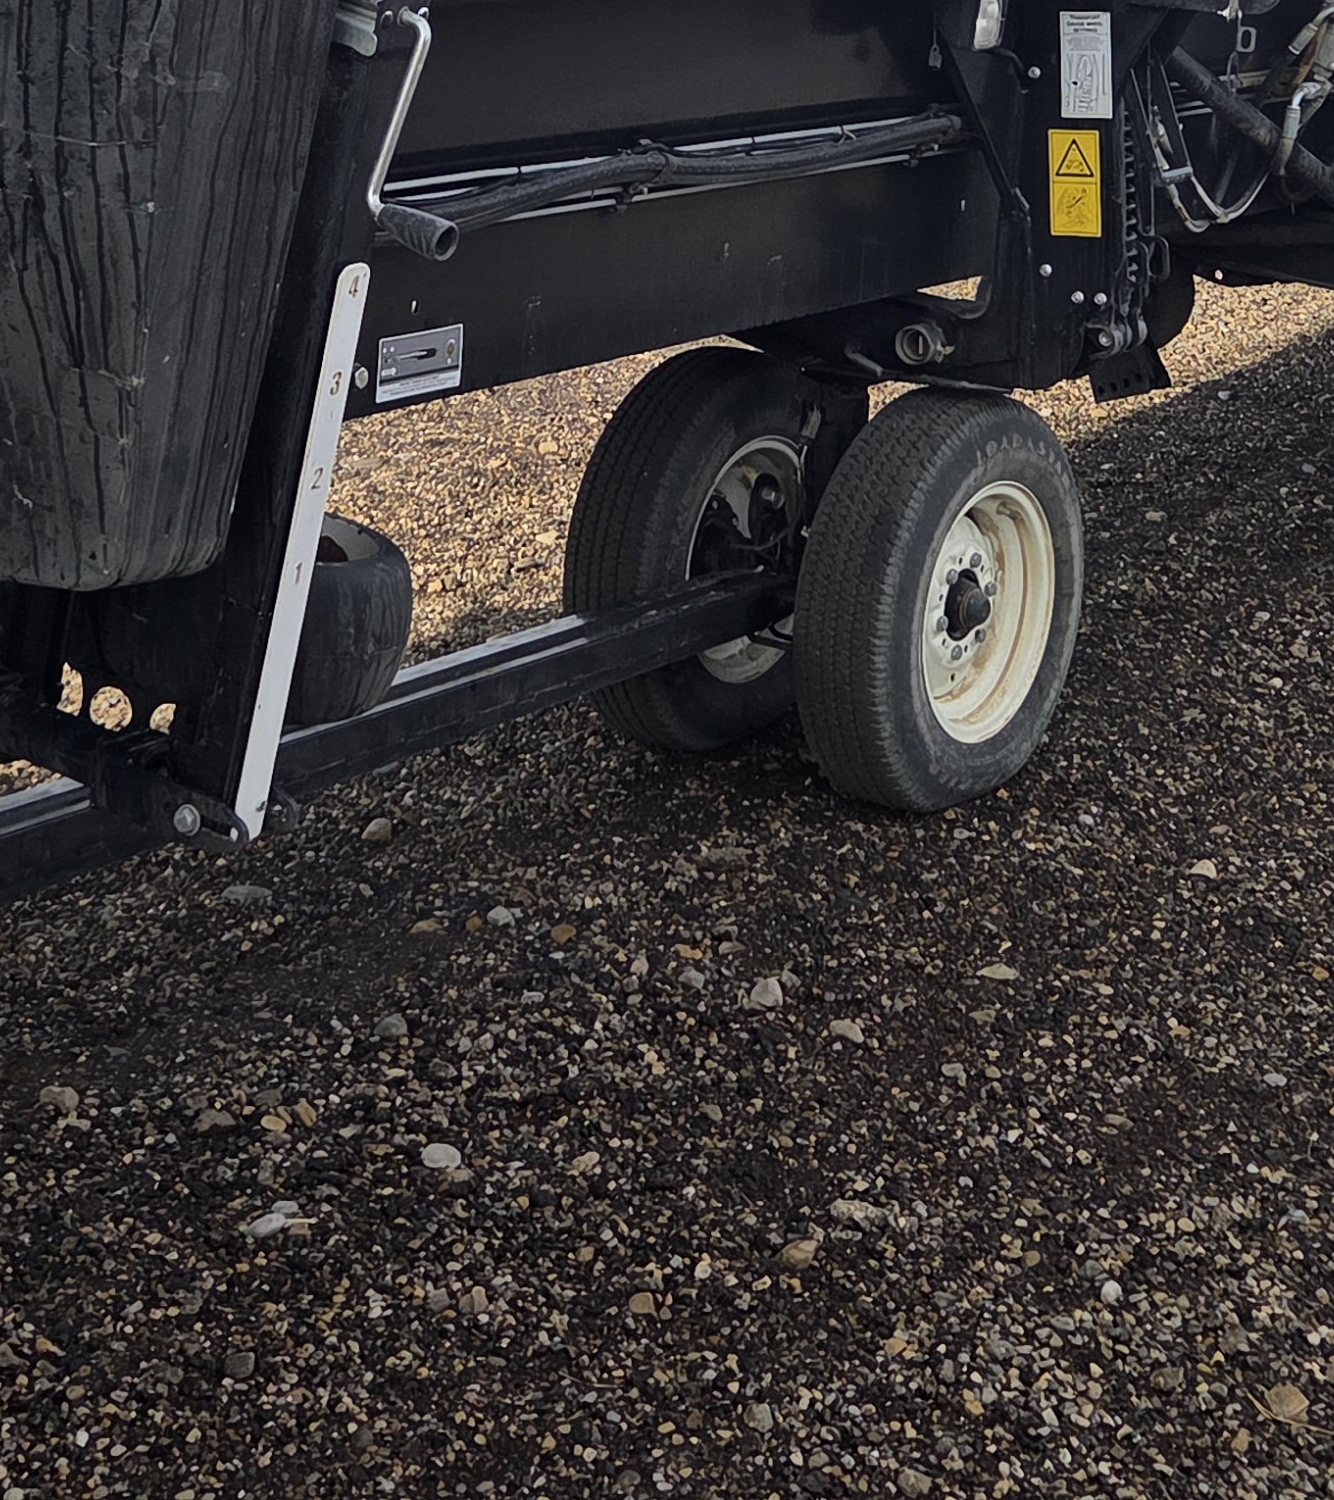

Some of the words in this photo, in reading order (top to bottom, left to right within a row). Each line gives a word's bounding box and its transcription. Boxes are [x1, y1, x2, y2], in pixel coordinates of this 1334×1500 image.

[348, 275, 361, 299] 4
[329, 371, 343, 396] 3
[310, 467, 324, 490] 2
[295, 562, 303, 585] 1
